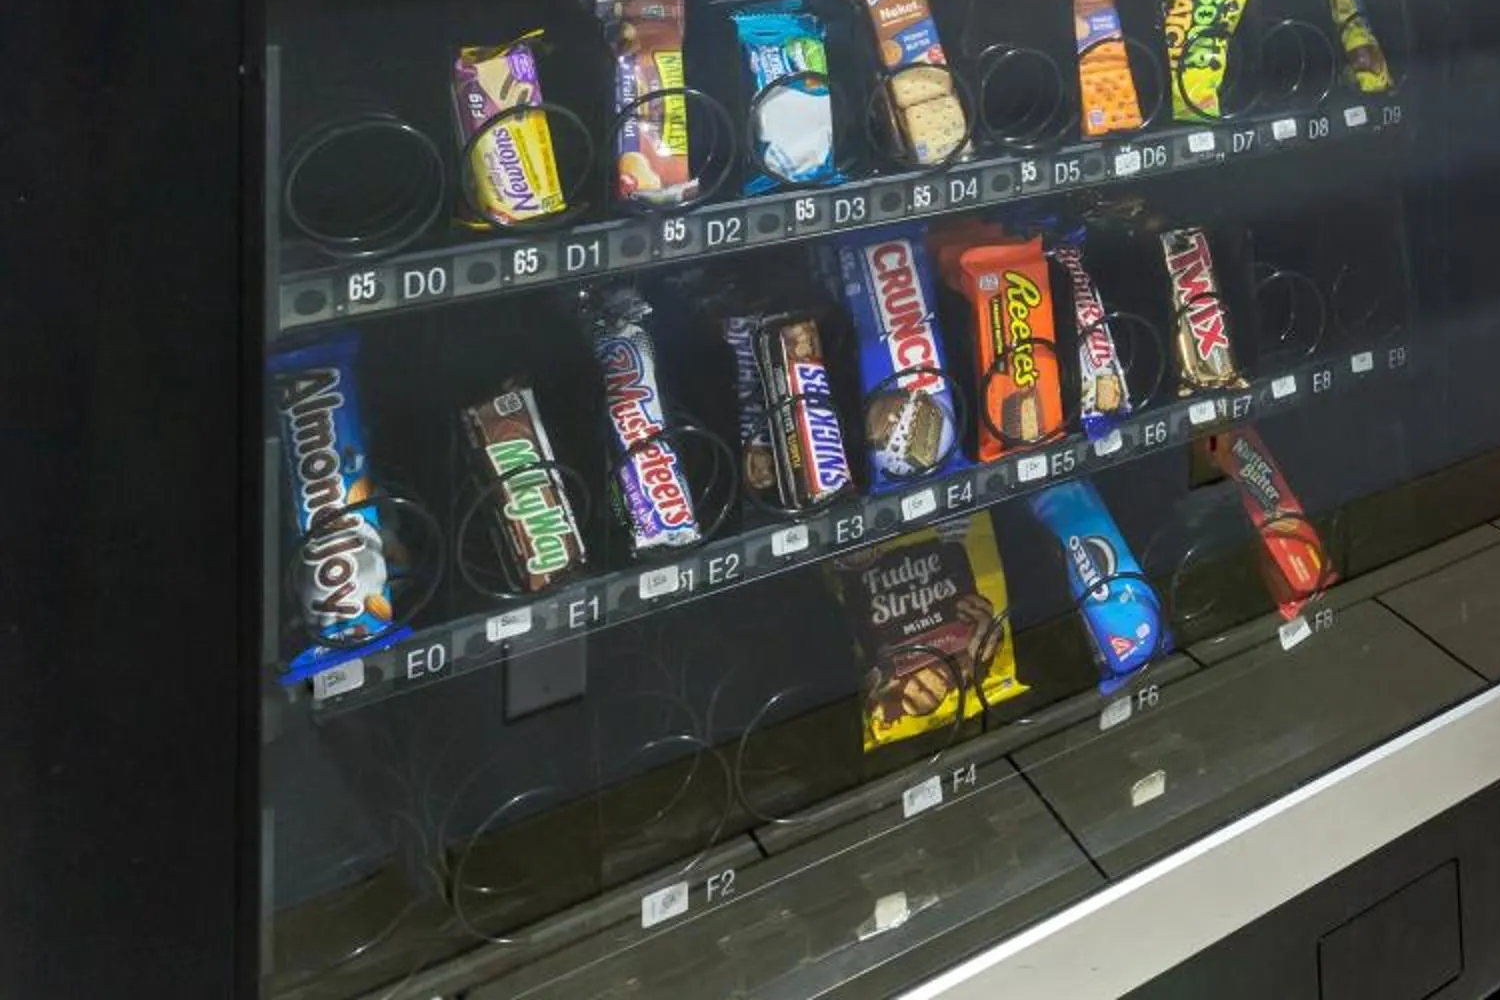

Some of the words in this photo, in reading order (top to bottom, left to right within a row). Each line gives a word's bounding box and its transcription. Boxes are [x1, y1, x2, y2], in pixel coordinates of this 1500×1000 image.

[1233, 130, 1255, 153] D7
[1309, 117, 1329, 139] D8
[494, 127, 540, 212] Newtons
[1143, 145, 1167, 169] D6
[1055, 159, 1081, 185] D5
[950, 177, 978, 203] D4
[835, 196, 866, 223] D3
[707, 217, 741, 246] D2
[567, 241, 599, 271] D1
[404, 267, 446, 299] D0
[1166, 233, 1229, 361] TWIX
[1003, 271, 1043, 388] Reese's
[1313, 370, 1331, 393] E8
[1233, 394, 1253, 418] E7
[1144, 421, 1167, 446] E6
[286, 367, 363, 537] Almond
[1051, 449, 1075, 475] E5
[947, 480, 973, 509] E4
[522, 505, 573, 575] Way
[836, 515, 865, 544] E3
[303, 530, 365, 620] Joy
[709, 553, 740, 585] E2
[861, 550, 942, 596] Fudge
[569, 596, 599, 628] E1
[870, 575, 957, 626] Stripes
[1315, 607, 1333, 632] F8
[407, 643, 446, 679] E0
[1138, 684, 1159, 710] F6
[952, 763, 976, 788] F4
[707, 869, 735, 903] F2
